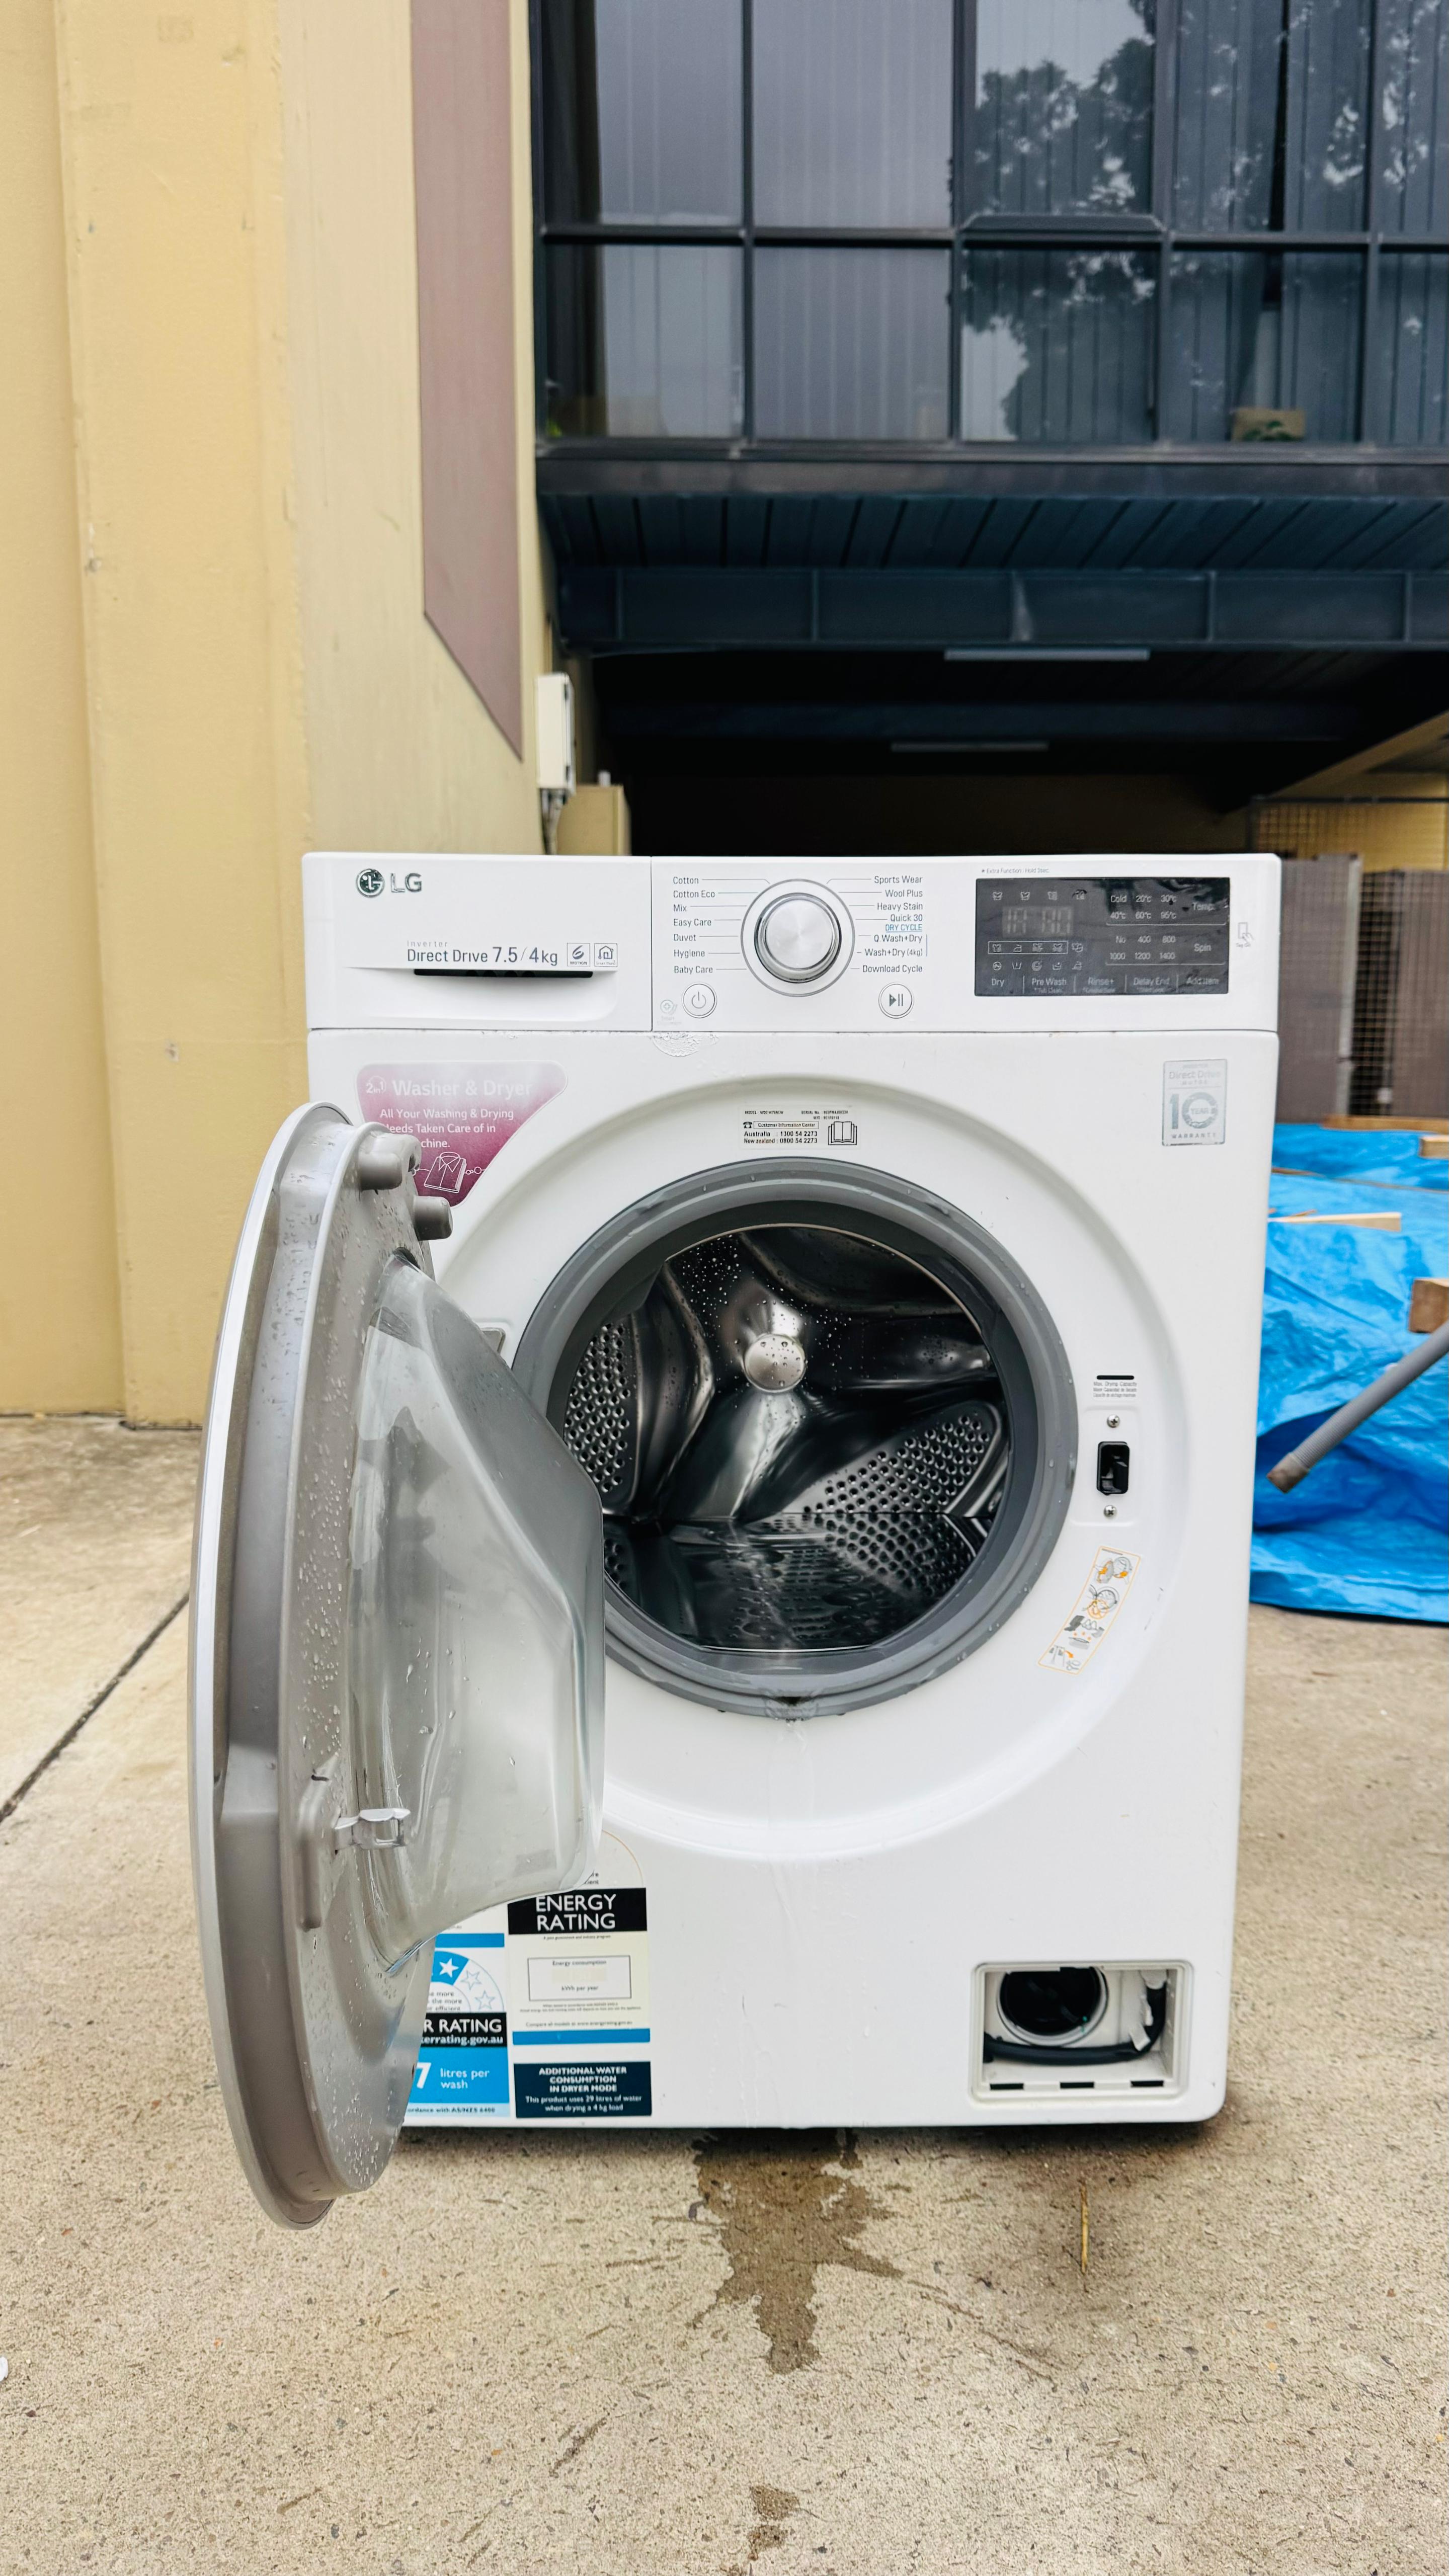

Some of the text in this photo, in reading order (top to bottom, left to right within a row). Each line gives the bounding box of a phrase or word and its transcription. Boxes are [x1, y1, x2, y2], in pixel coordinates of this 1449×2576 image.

[390, 872, 422, 893] LG
[673, 876, 699, 884] Cotton
[874, 875, 923, 884] Sports Wear
[673, 890, 715, 898] Cotton Eco
[885, 889, 923, 897] Wool Plus
[1110, 895, 1127, 903] Cold
[877, 902, 923, 912] Heavy Stain
[673, 918, 711, 928] Easy Care
[890, 914, 923, 922] Quick 30
[864, 948, 923, 957] Wash+Dry (4kg)
[1194, 943, 1212, 953] Spin
[407, 949, 449, 962] Direct
[453, 949, 488, 962] Drive
[674, 949, 705, 958] Hygiene
[674, 965, 713, 975] Baby Care
[862, 964, 922, 974] Download Cycle
[991, 978, 1005, 987] Dry
[1032, 978, 1067, 986] Pre Wash
[392, 1080, 459, 1096] Washer
[465, 1081, 477, 1096] &
[484, 1080, 532, 1100] Dryer
[380, 1108, 514, 1120] All Your Washing & Drying
[416, 1123, 445, 1134] Taken
[447, 1123, 471, 1133] Care
[473, 1122, 484, 1133] of
[487, 1122, 496, 1133] in
[421, 1138, 450, 1148] chine.
[535, 1894, 617, 1912] ENERGY
[537, 1913, 616, 1931] RATING
[439, 2019, 502, 2033] RATING
[440, 2068, 490, 2080] litres per
[538, 2066, 627, 2075] ADDITIONAL WATER
[440, 2079, 468, 2089] wash
[549, 2075, 617, 2084] CONSUMPTION
[549, 2084, 617, 2093] IN DRYER MODE
[525, 2096, 539, 2104] This
[540, 2096, 568, 2105] product
[565, 2104, 586, 2113] drying
